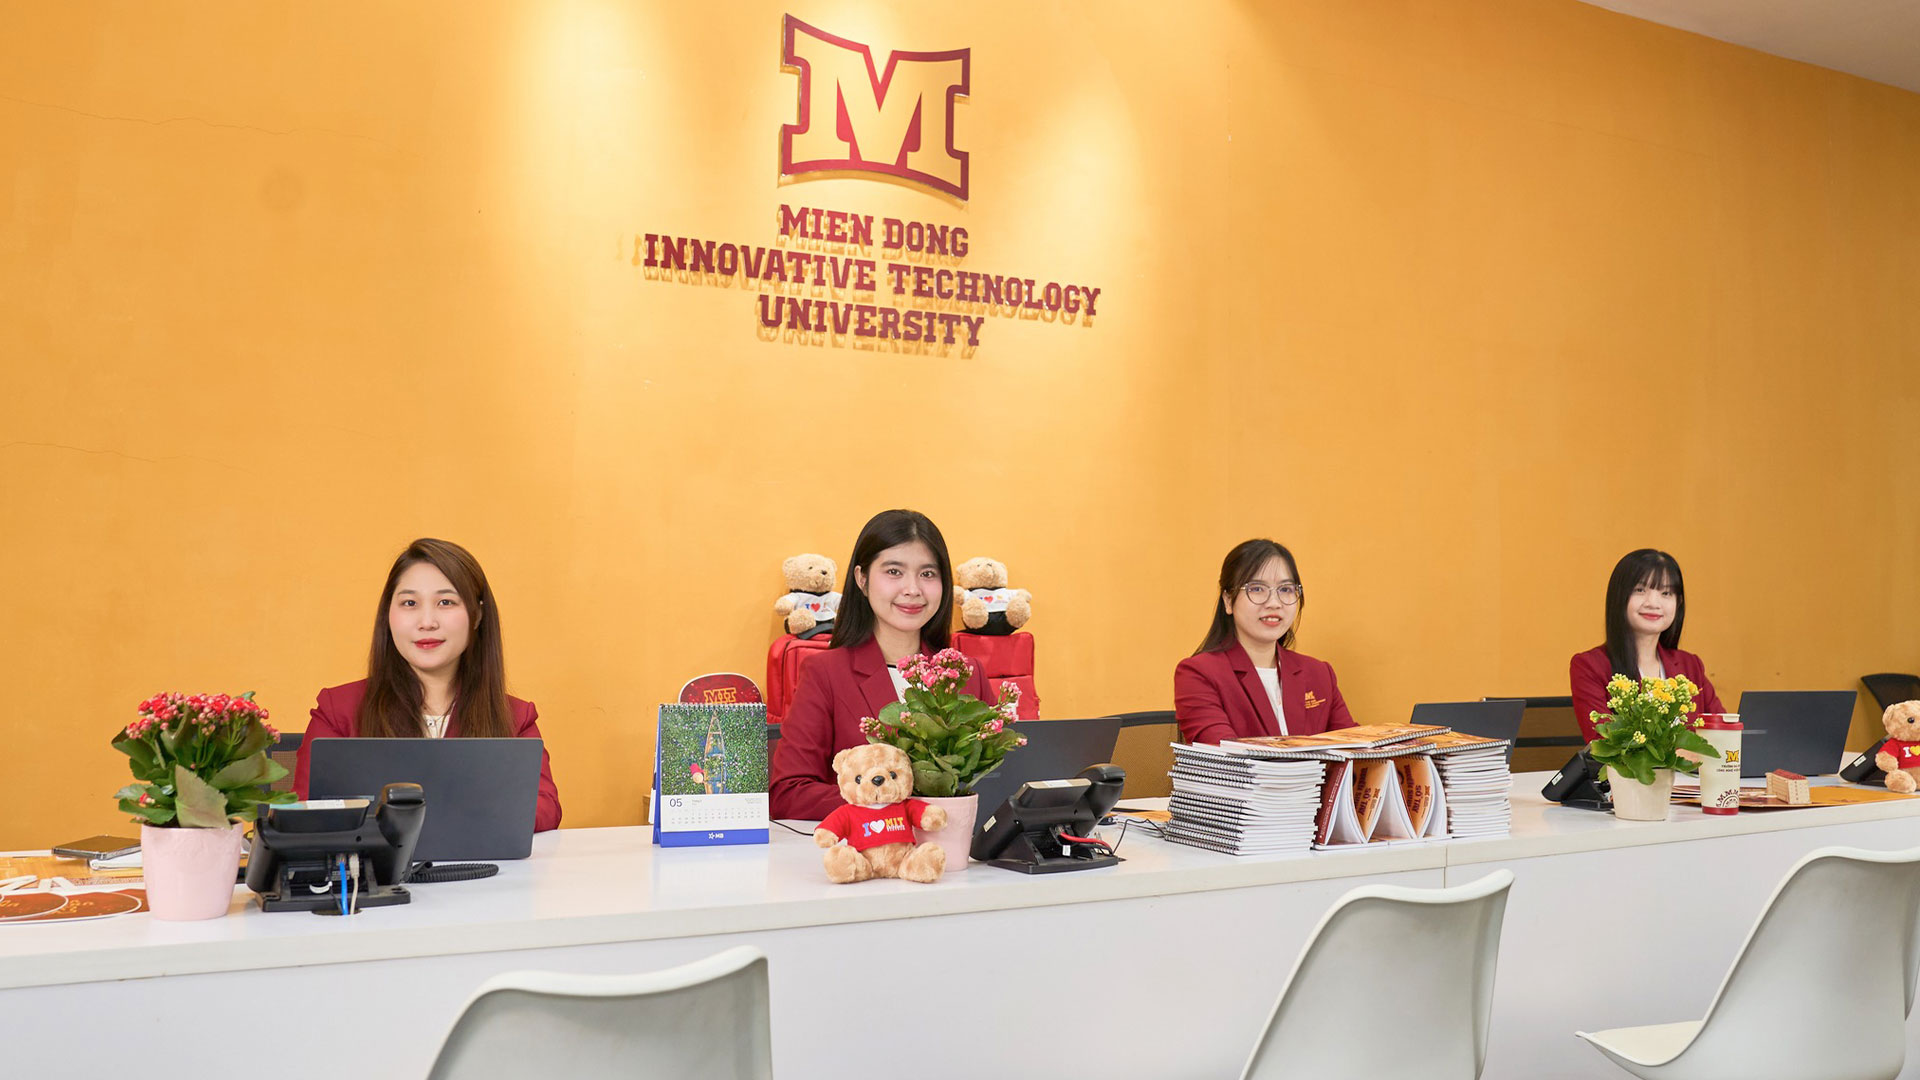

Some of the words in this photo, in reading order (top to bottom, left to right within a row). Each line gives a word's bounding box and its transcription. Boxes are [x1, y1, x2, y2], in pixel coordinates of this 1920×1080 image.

[782, 13, 970, 201] M
[780, 204, 874, 246] MIEN
[882, 216, 969, 257] DONG
[644, 233, 876, 291] INNOVATIVE
[887, 263, 1101, 316] TECHNOLOGY
[758, 295, 985, 346] UNIVERSITY
[703, 687, 736, 704] MIT
[1725, 750, 1739, 763] M
[1903, 746, 1912, 758] I
[669, 798, 682, 808] 05
[1358, 803, 1368, 815] TAY
[1412, 801, 1421, 813] TAY
[862, 822, 872, 837] I
[884, 816, 904, 827] MIT
